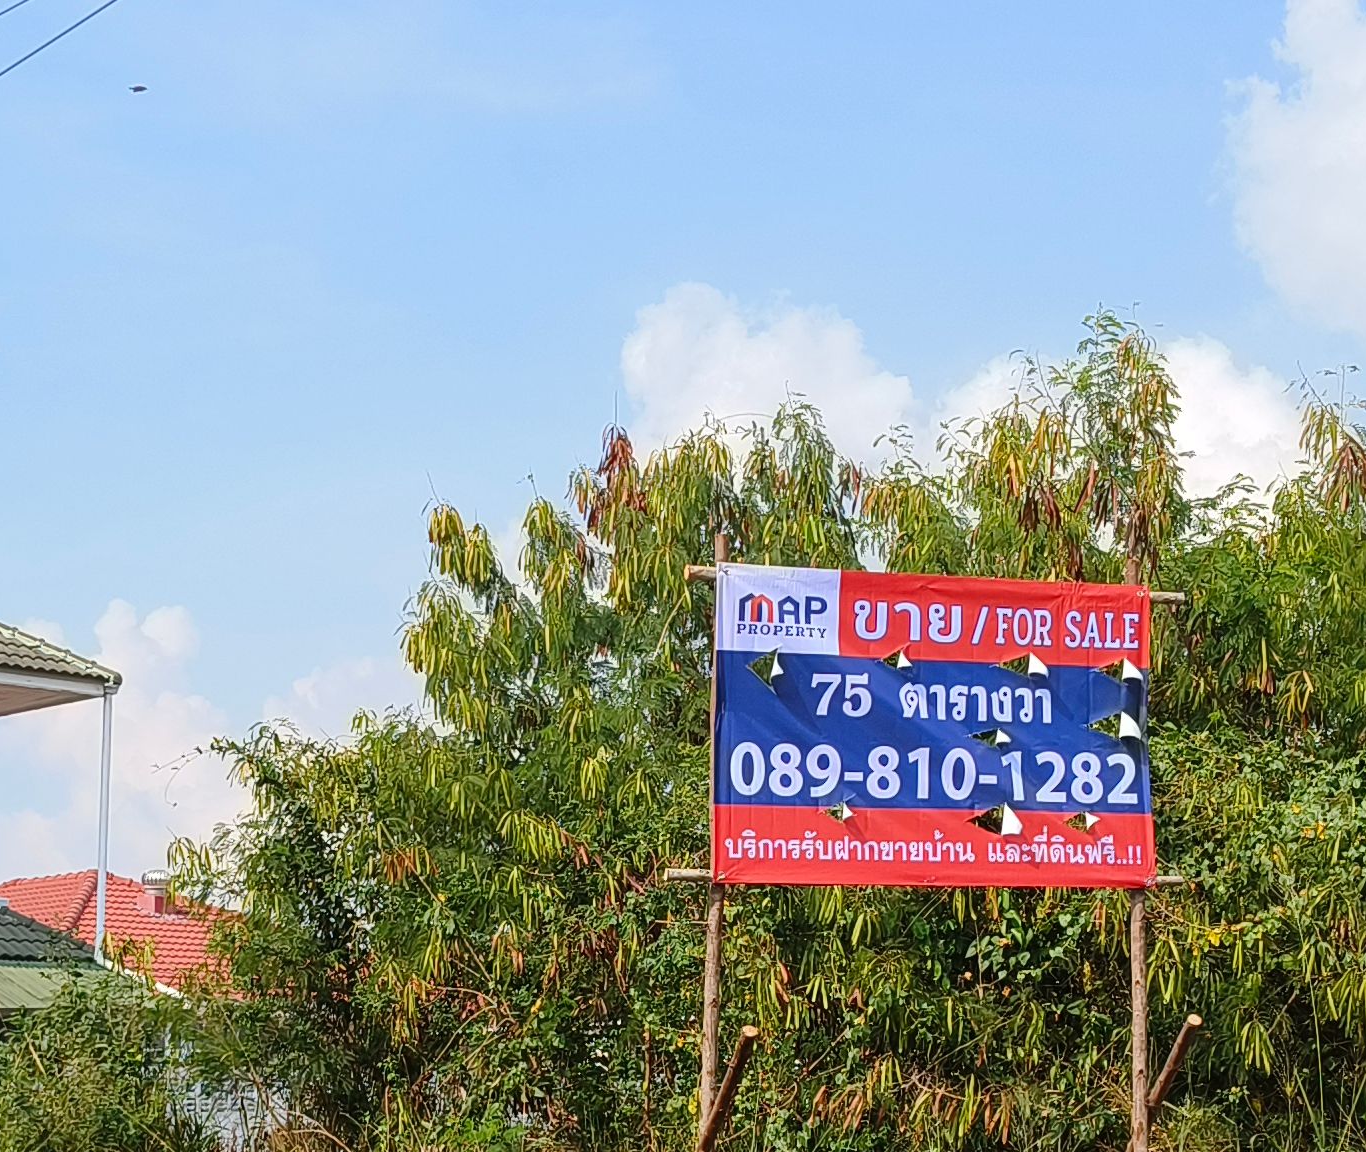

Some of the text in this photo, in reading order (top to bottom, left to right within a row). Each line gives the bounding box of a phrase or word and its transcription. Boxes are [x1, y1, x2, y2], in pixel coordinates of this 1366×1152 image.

[737, 623, 827, 639] PROPERTY
[738, 593, 828, 624] MAP
[853, 599, 963, 643] ขาย
[1064, 610, 1140, 649] SALE
[810, 672, 1053, 725] 75 ตารางวา
[729, 741, 1139, 806] 089-810-1282
[724, 825, 1143, 865] บริการรับฝากขายบ้าน และที่ดินฟรี..!!
